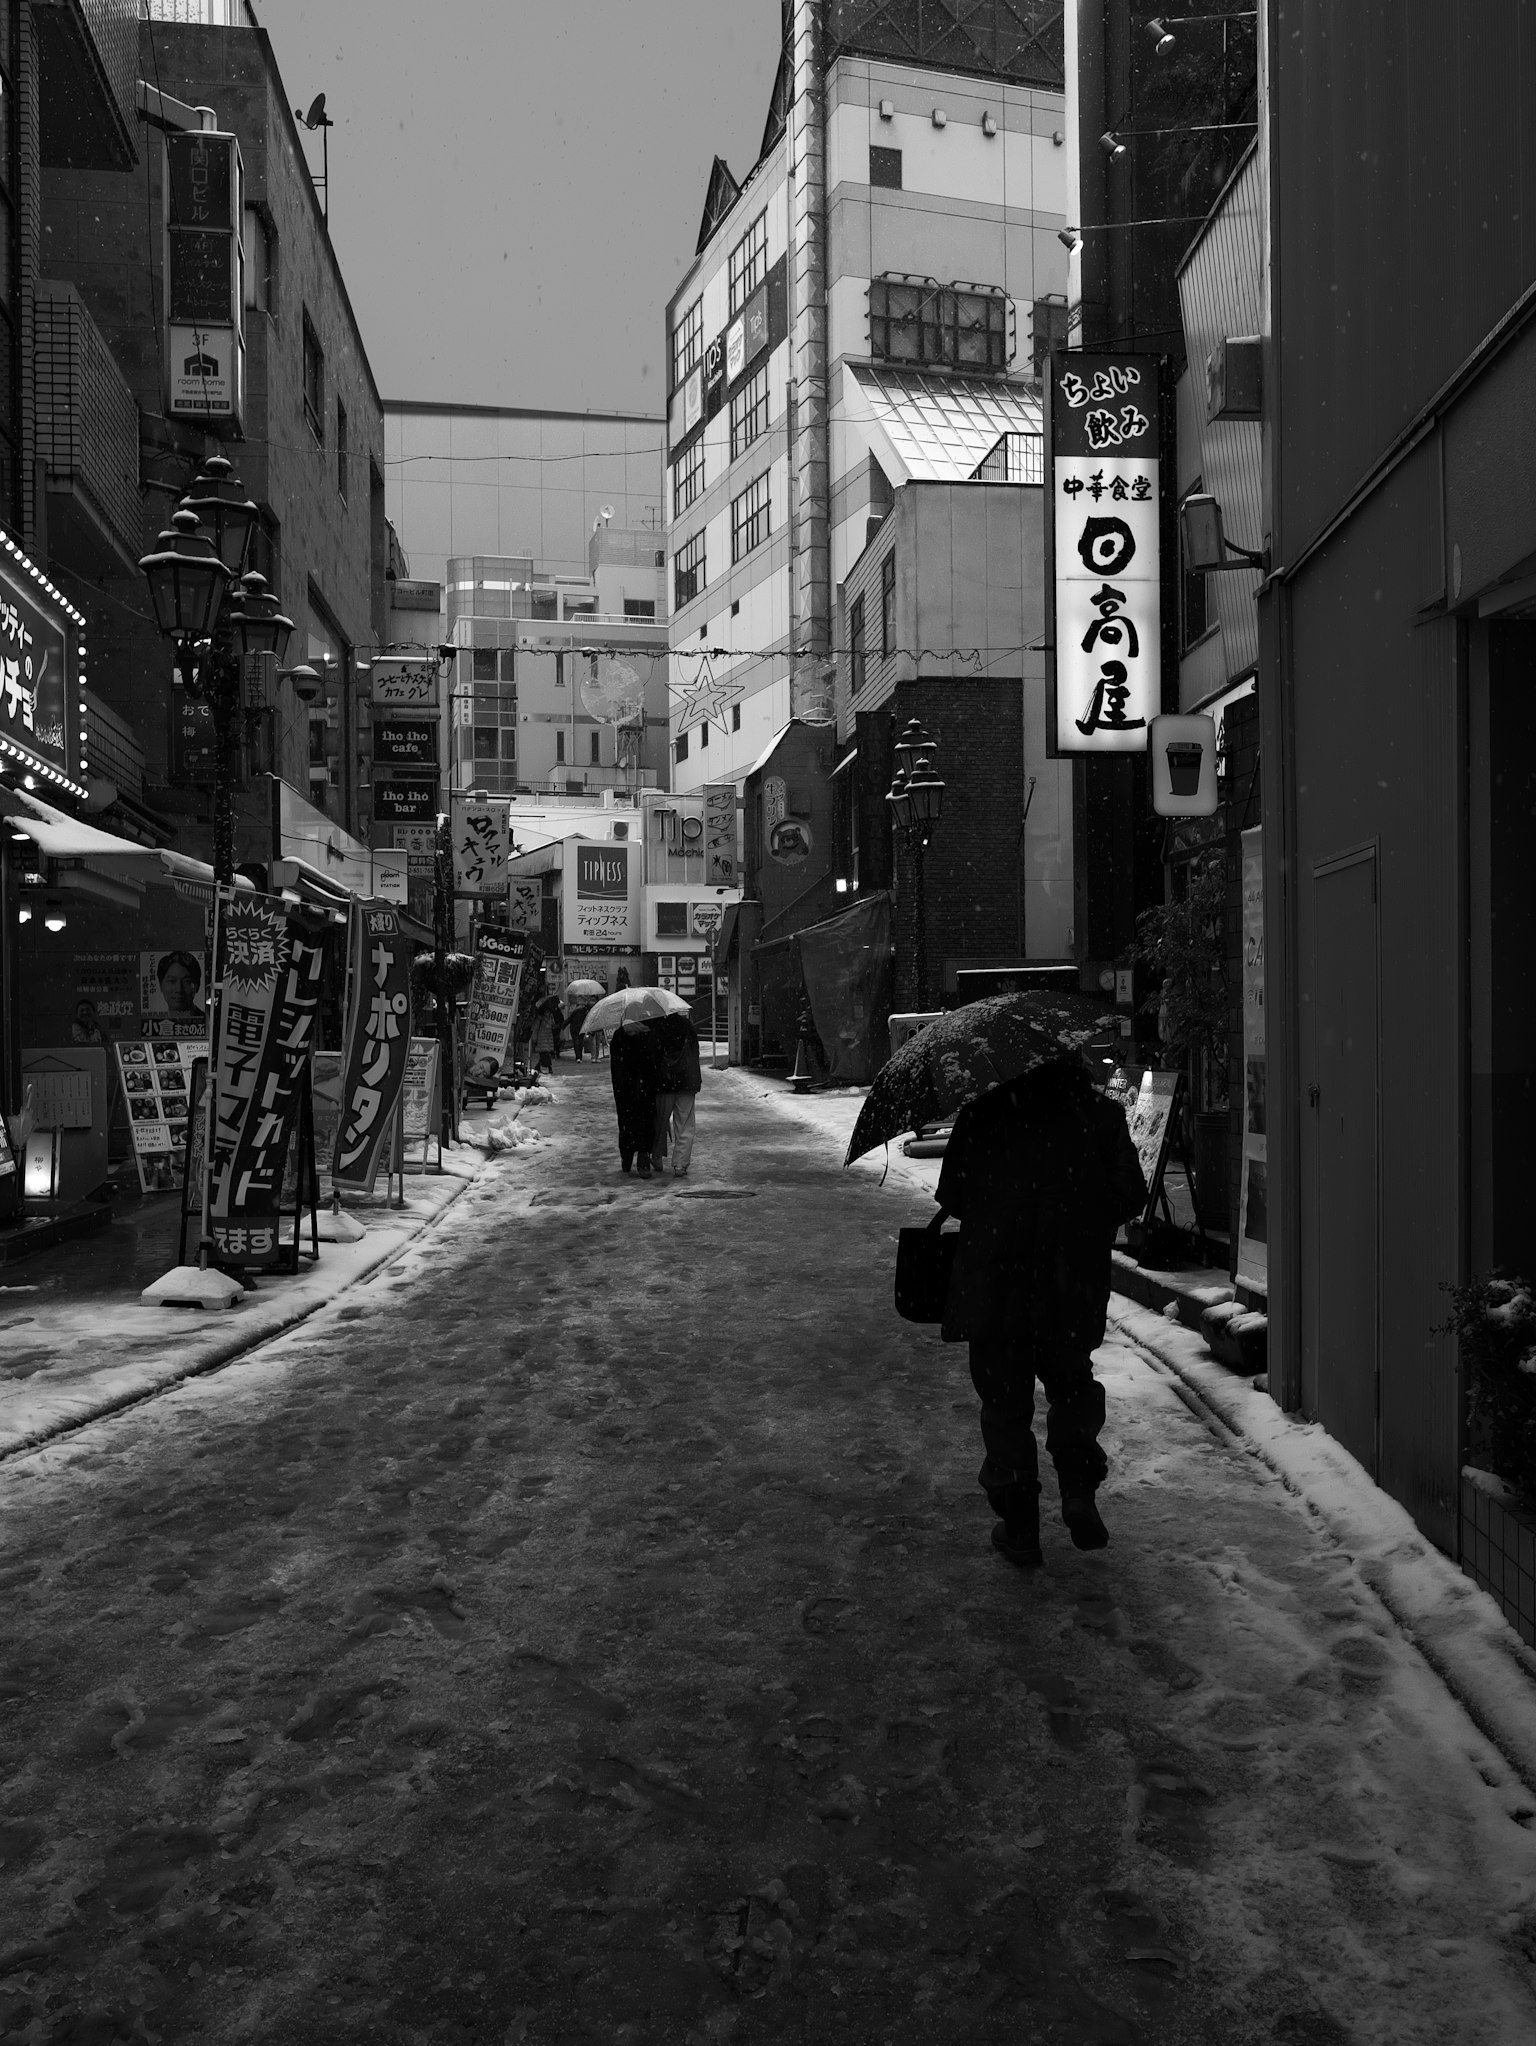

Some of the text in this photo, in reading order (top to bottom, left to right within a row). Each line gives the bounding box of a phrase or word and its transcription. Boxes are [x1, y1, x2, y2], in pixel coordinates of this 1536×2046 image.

[192, 333, 210, 347] 3F
[177, 378, 226, 387] room home
[1060, 365, 1142, 409] ちょい
[1084, 404, 1149, 449] 飲み
[1063, 469, 1153, 503] 中華食堂
[0, 594, 34, 650] ッティー
[1076, 516, 1147, 736] 日高屋
[384, 686, 405, 699] カフェ
[382, 730, 429, 743] iho iho
[391, 742, 418, 754] cafe
[382, 790, 429, 802] iho iho
[394, 802, 417, 814] bar
[583, 853, 622, 888] TIPNESS
[577, 904, 628, 914] フィットネスクラブ
[693, 912, 721, 921] カラオケ
[577, 914, 628, 927] ティップネス
[698, 920, 718, 929] マック
[225, 926, 273, 942] らくらく
[227, 941, 277, 967] 決済
[141, 1018, 205, 1037] 小倉まさのぶ
[339, 940, 409, 1171] ナポリタン
[234, 939, 324, 1208] クレジットカード
